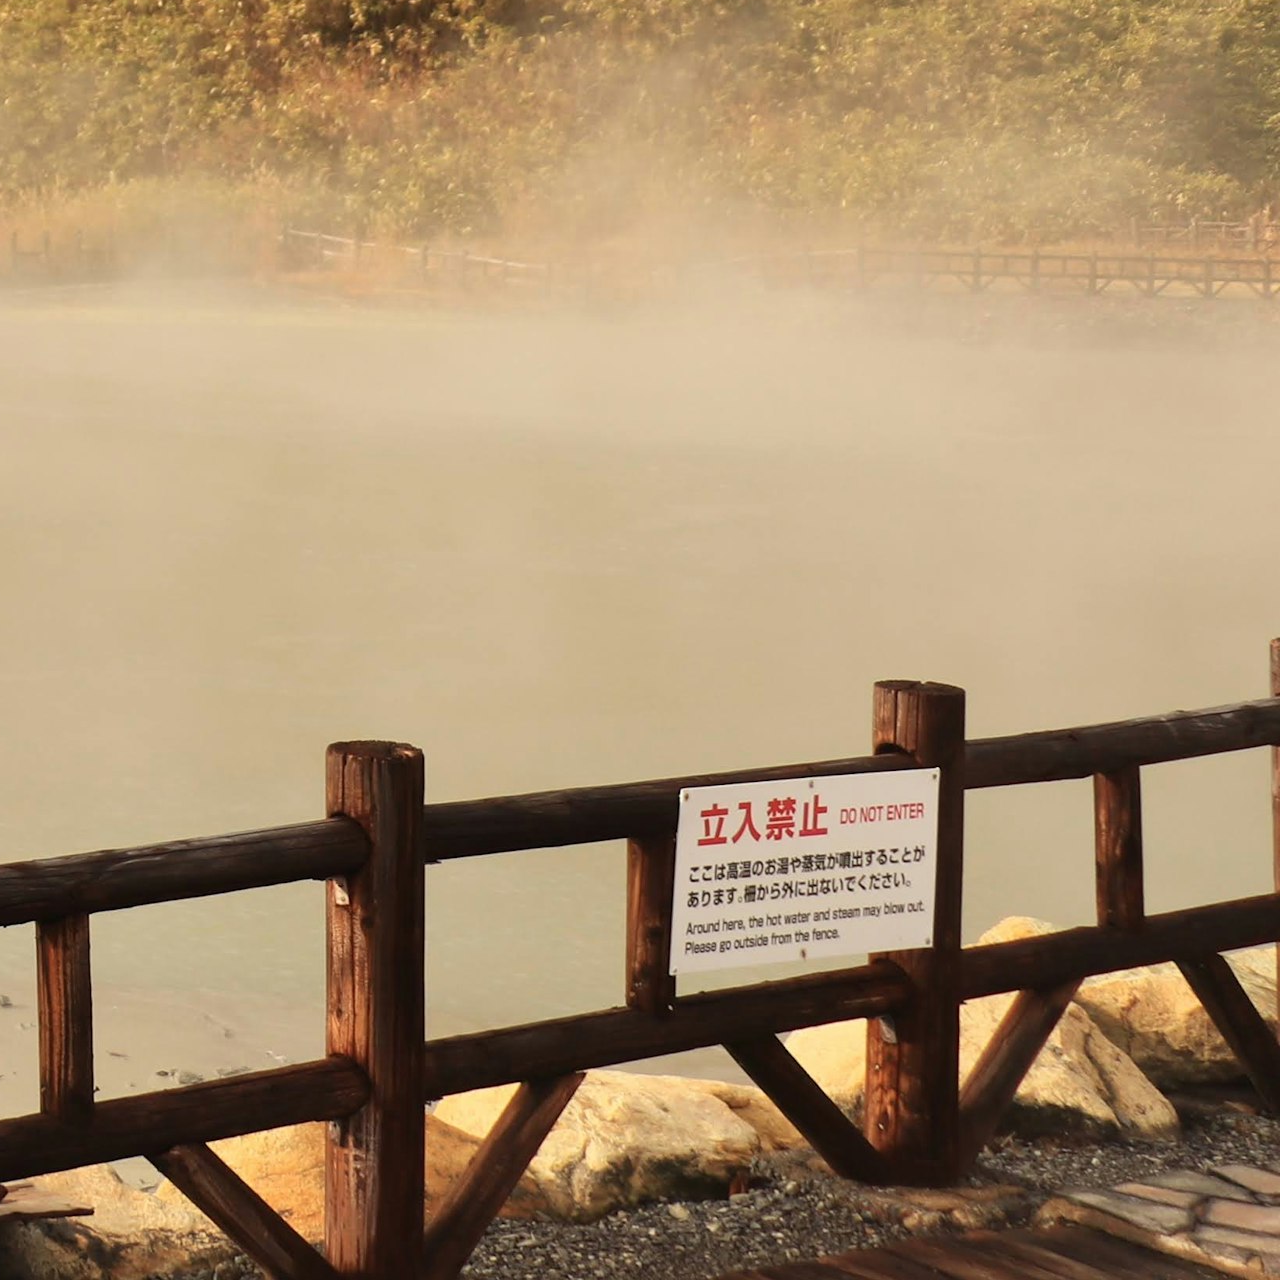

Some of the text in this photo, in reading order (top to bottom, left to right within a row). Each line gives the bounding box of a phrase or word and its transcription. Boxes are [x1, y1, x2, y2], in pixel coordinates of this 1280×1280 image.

[698, 795, 828, 846] 立入禁止
[840, 803, 924, 824] DO NOT ENTER
[689, 846, 925, 883] ここは高温のお湯や蒸気が噴出することが
[687, 873, 911, 908] あります。柵から外に出ないでください。
[686, 901, 925, 935] Around here, the hot water and steam may blow out.
[685, 928, 840, 954] Please go outside from the fence.
